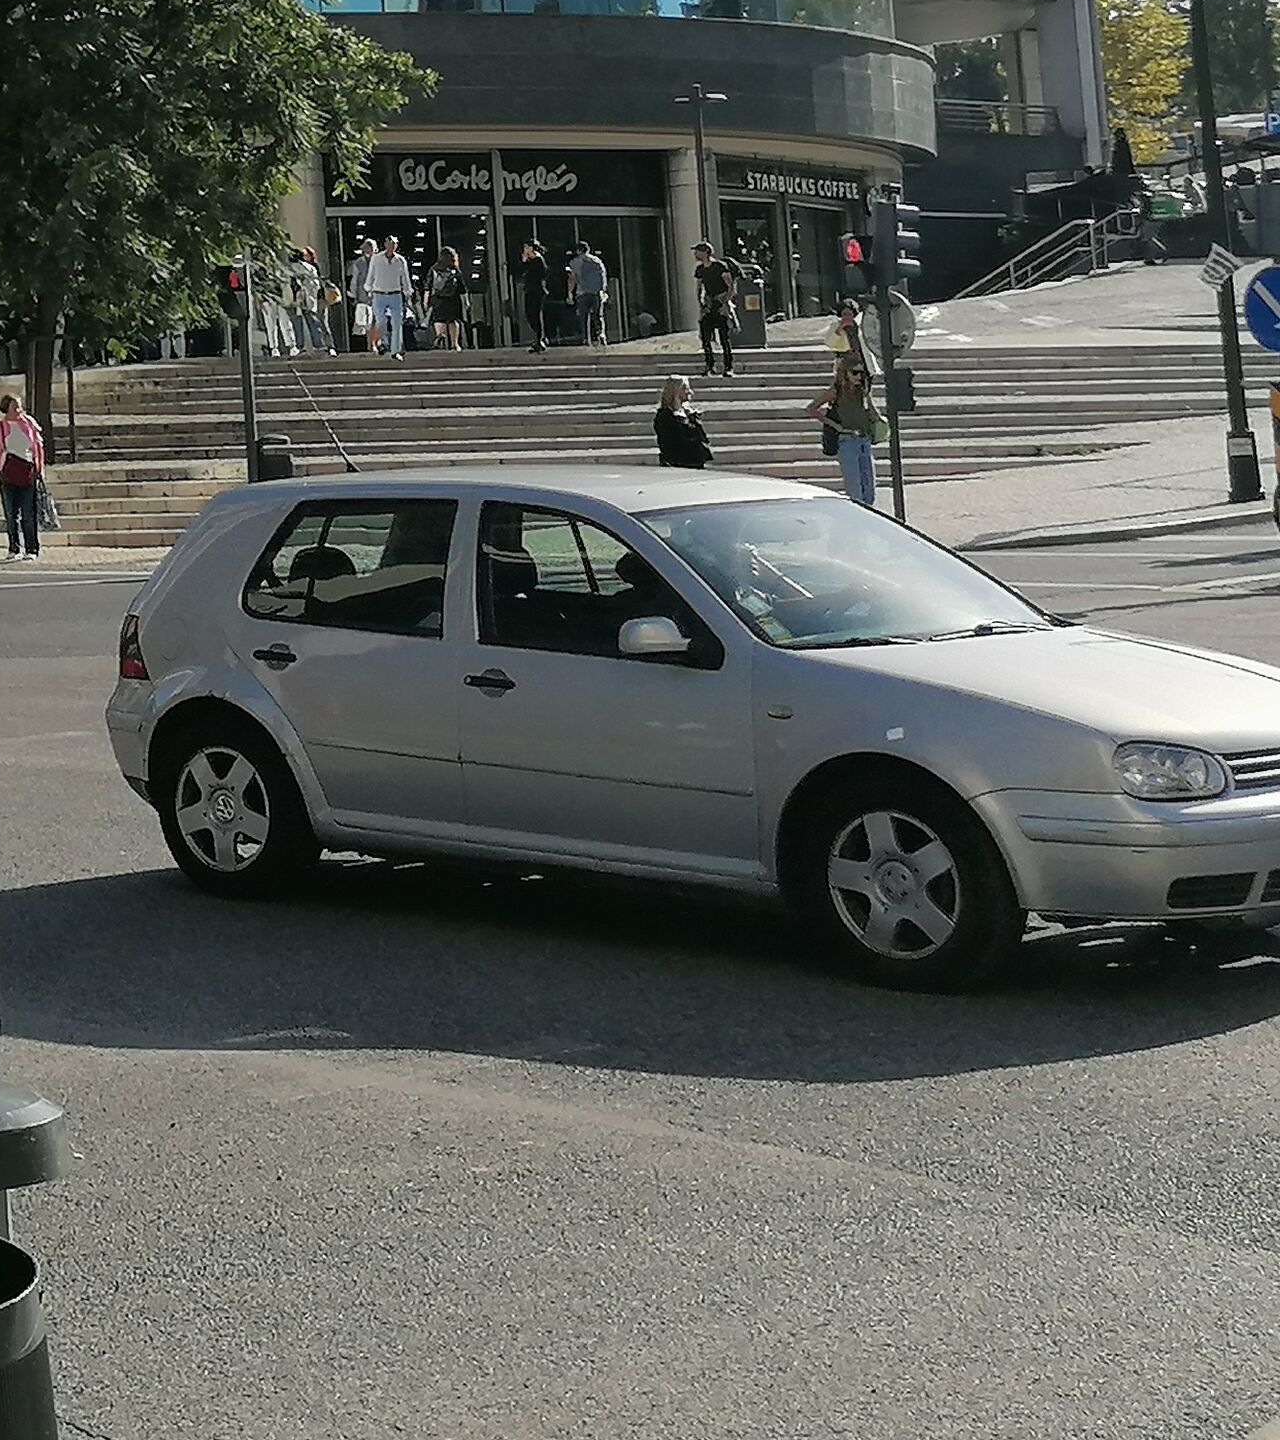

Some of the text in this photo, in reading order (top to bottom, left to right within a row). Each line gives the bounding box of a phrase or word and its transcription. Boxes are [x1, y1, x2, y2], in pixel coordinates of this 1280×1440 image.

[398, 159, 428, 192] El
[428, 160, 491, 192] Corte
[746, 171, 860, 200] STARBUCKS COFFEE
